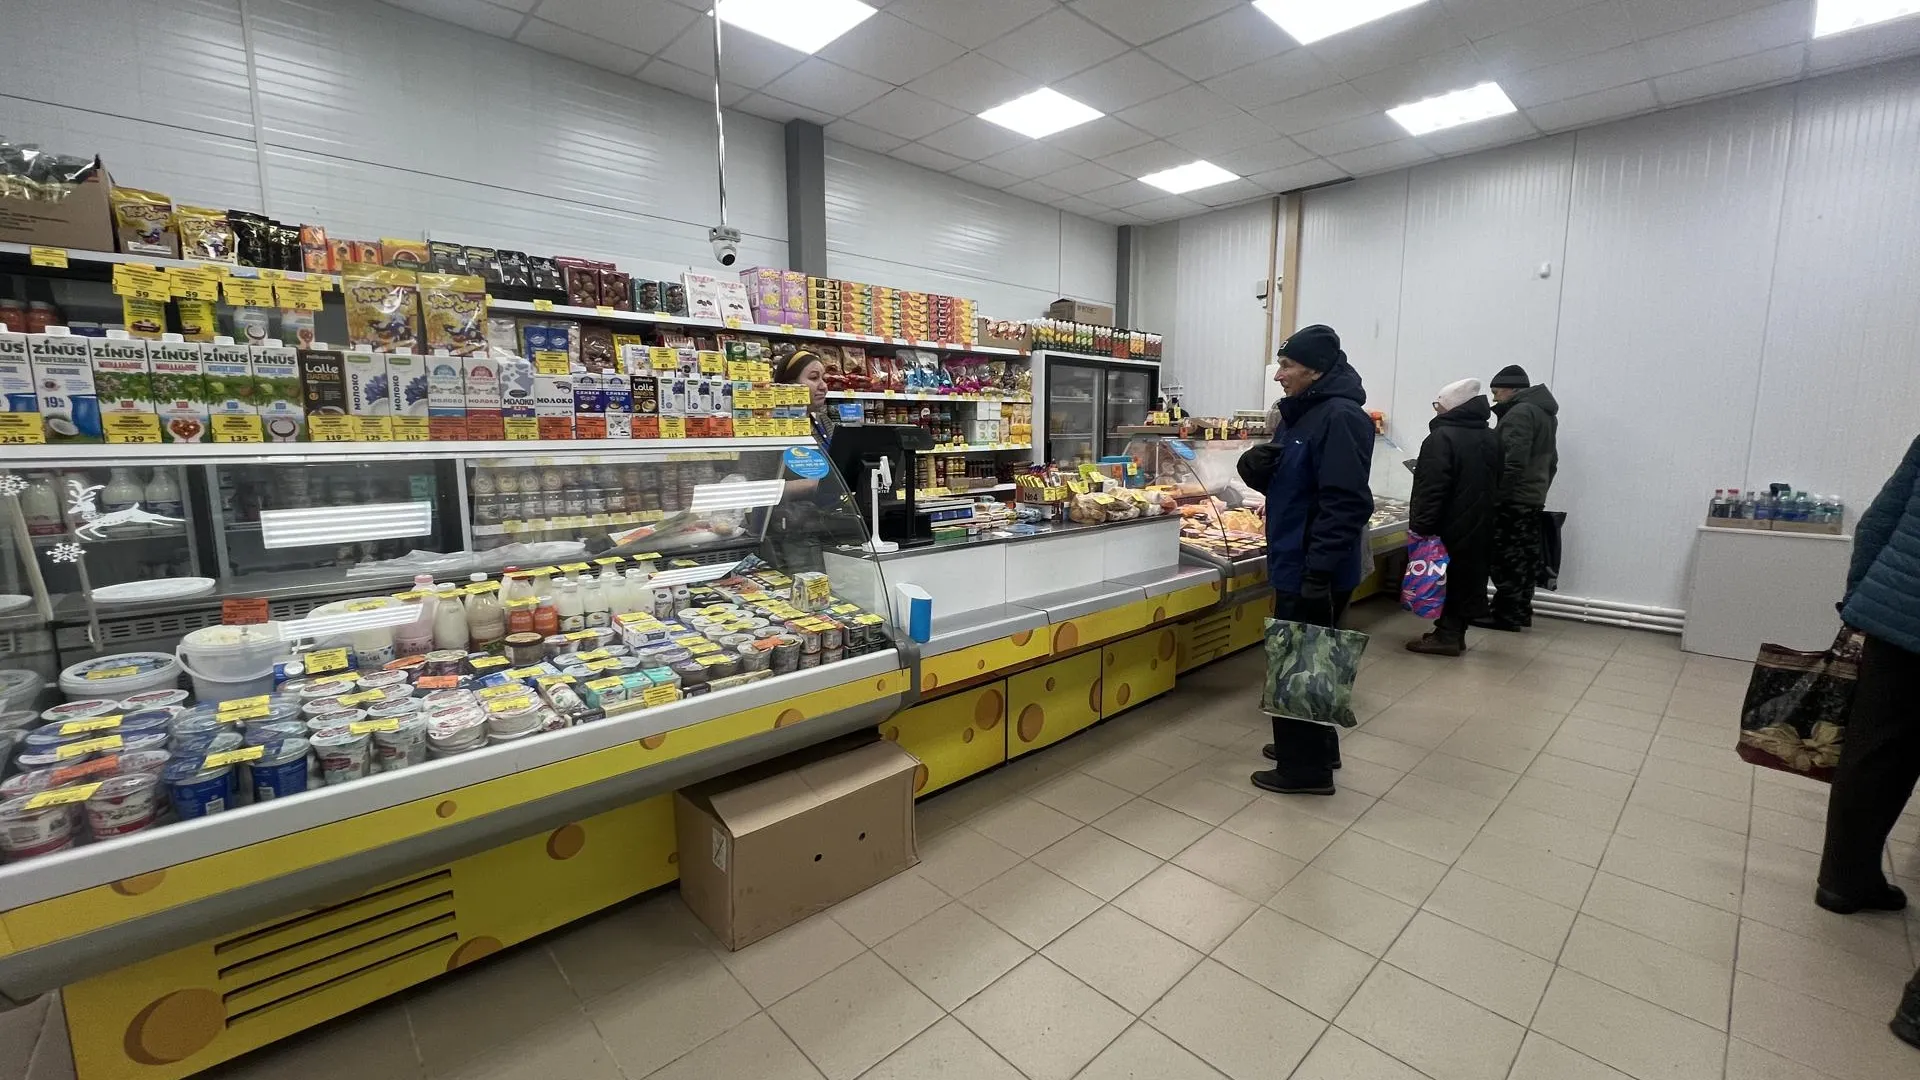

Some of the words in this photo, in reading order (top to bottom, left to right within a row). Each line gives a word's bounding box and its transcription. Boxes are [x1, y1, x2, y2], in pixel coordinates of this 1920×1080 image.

[135, 290, 149, 298] 59
[185, 290, 199, 298] 59
[351, 373, 361, 411] МОЛОКО
[392, 375, 402, 411] МОЛОКО
[503, 398, 535, 406] МОЛОКО
[2, 435, 25, 443] 245
[123, 435, 145, 443] 129
